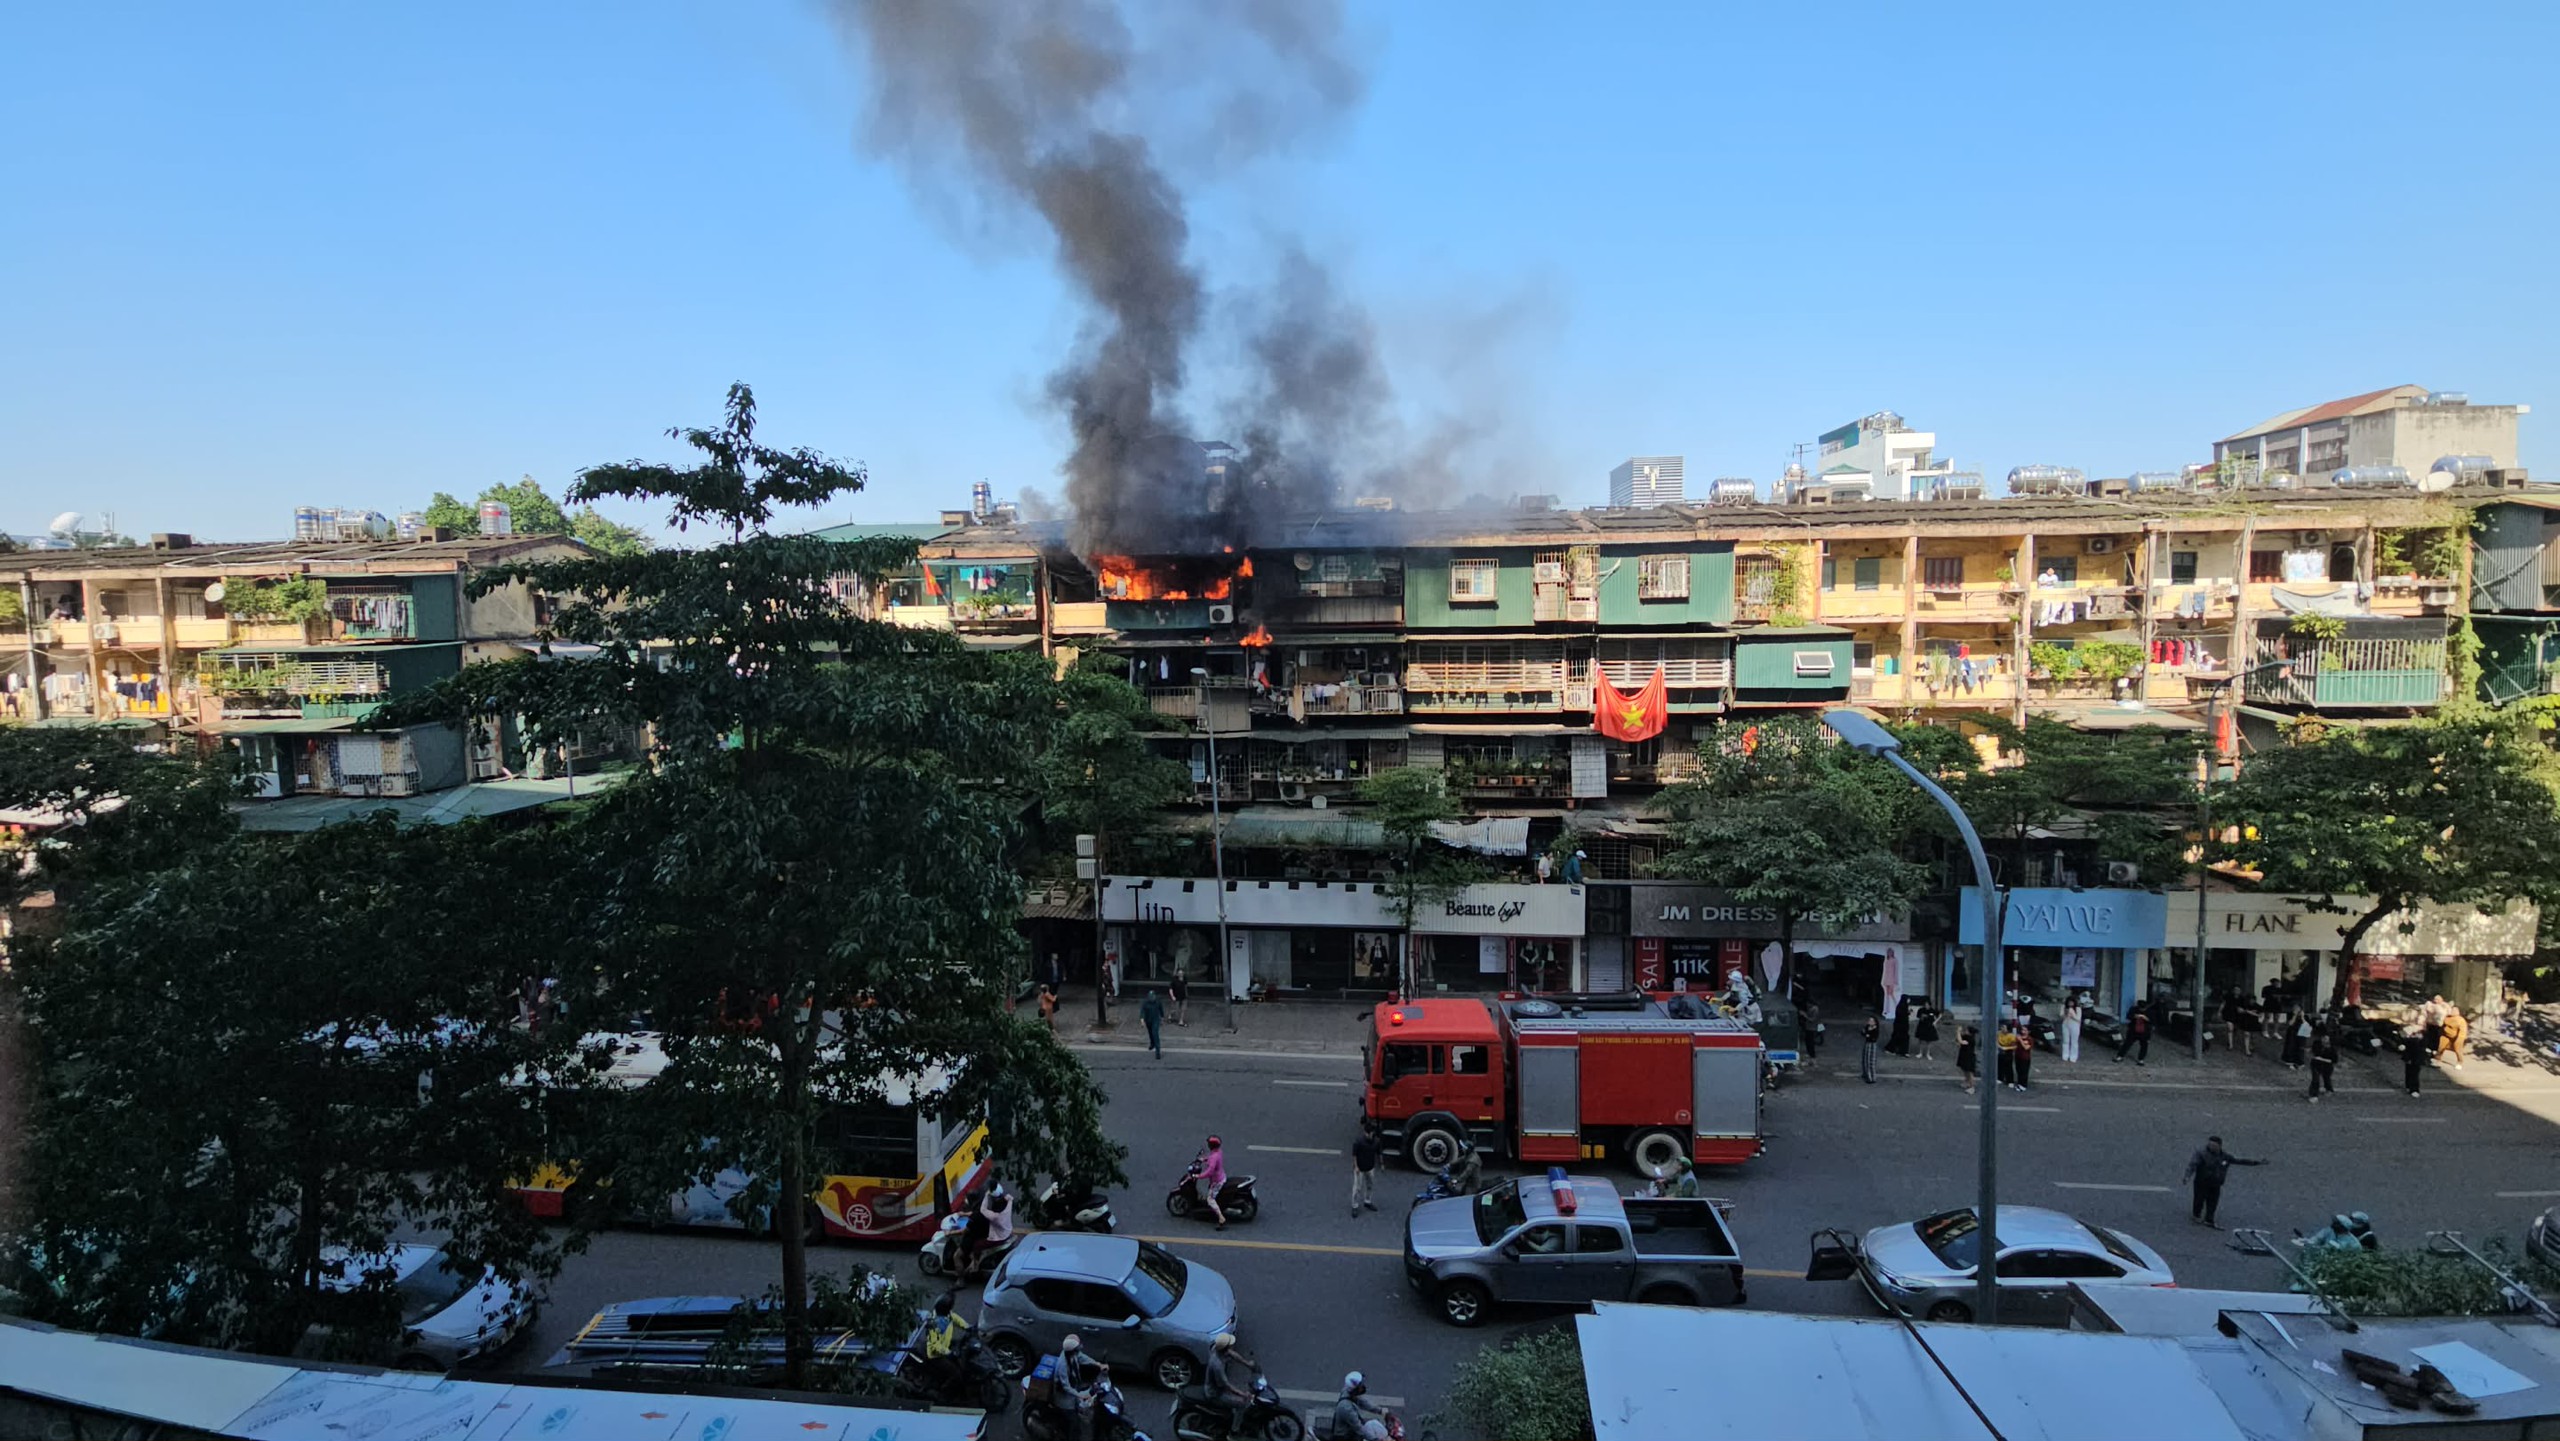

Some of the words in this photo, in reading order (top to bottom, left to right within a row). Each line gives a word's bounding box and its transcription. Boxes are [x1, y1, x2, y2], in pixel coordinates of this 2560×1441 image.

[1126, 885, 1175, 923] Tiin
[1659, 905, 1690, 921] JM
[1702, 906, 1778, 922] DRESS
[1642, 939, 1658, 989] SALE
[1673, 959, 1711, 975] 111K
[1726, 940, 1742, 974] ALE
